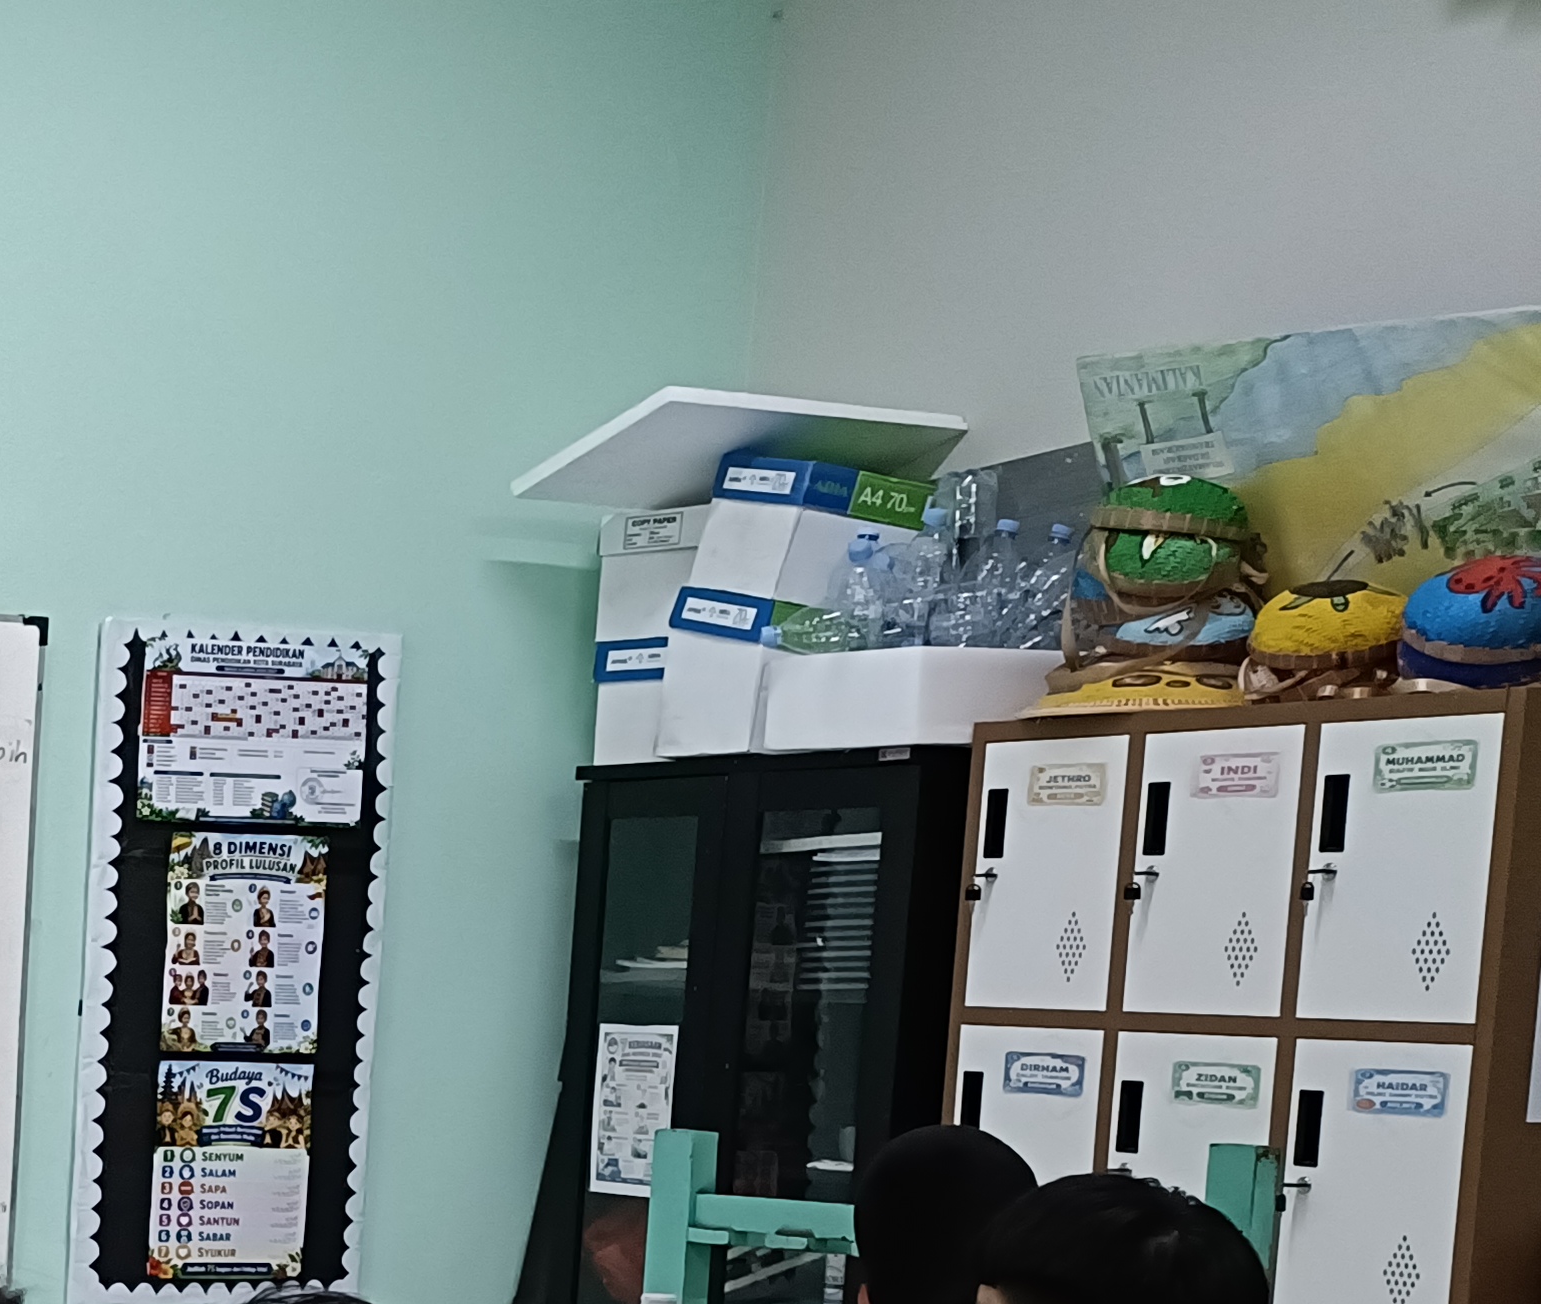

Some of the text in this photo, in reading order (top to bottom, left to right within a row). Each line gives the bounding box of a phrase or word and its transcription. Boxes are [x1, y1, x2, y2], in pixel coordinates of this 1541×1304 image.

[858, 486, 883, 507] A4
[886, 492, 907, 512] 70
[631, 516, 677, 527] COPY PAPER
[190, 642, 305, 660] KALENDER PENDIDIKAN
[1385, 754, 1466, 766] MUHAMMAD
[1220, 765, 1259, 776] INDI
[1046, 774, 1092, 784] JETHRO
[212, 841, 292, 857] 8 DIMENSI
[205, 858, 298, 874] PROFIL LULUSAN
[1020, 1063, 1070, 1074] DIRHAM
[205, 1066, 263, 1085] Budaya
[1195, 1073, 1238, 1084] ZIDAN
[1376, 1081, 1428, 1092] HAIDAR
[205, 1085, 267, 1124] 7S
[201, 1151, 244, 1162] SENYUM
[201, 1167, 237, 1178] SALAM
[200, 1184, 228, 1194] SAPA
[199, 1200, 234, 1210] SOPAN
[198, 1216, 240, 1226] SANTUN
[198, 1231, 232, 1242] SABAR
[198, 1247, 237, 1258] SYUKUR
